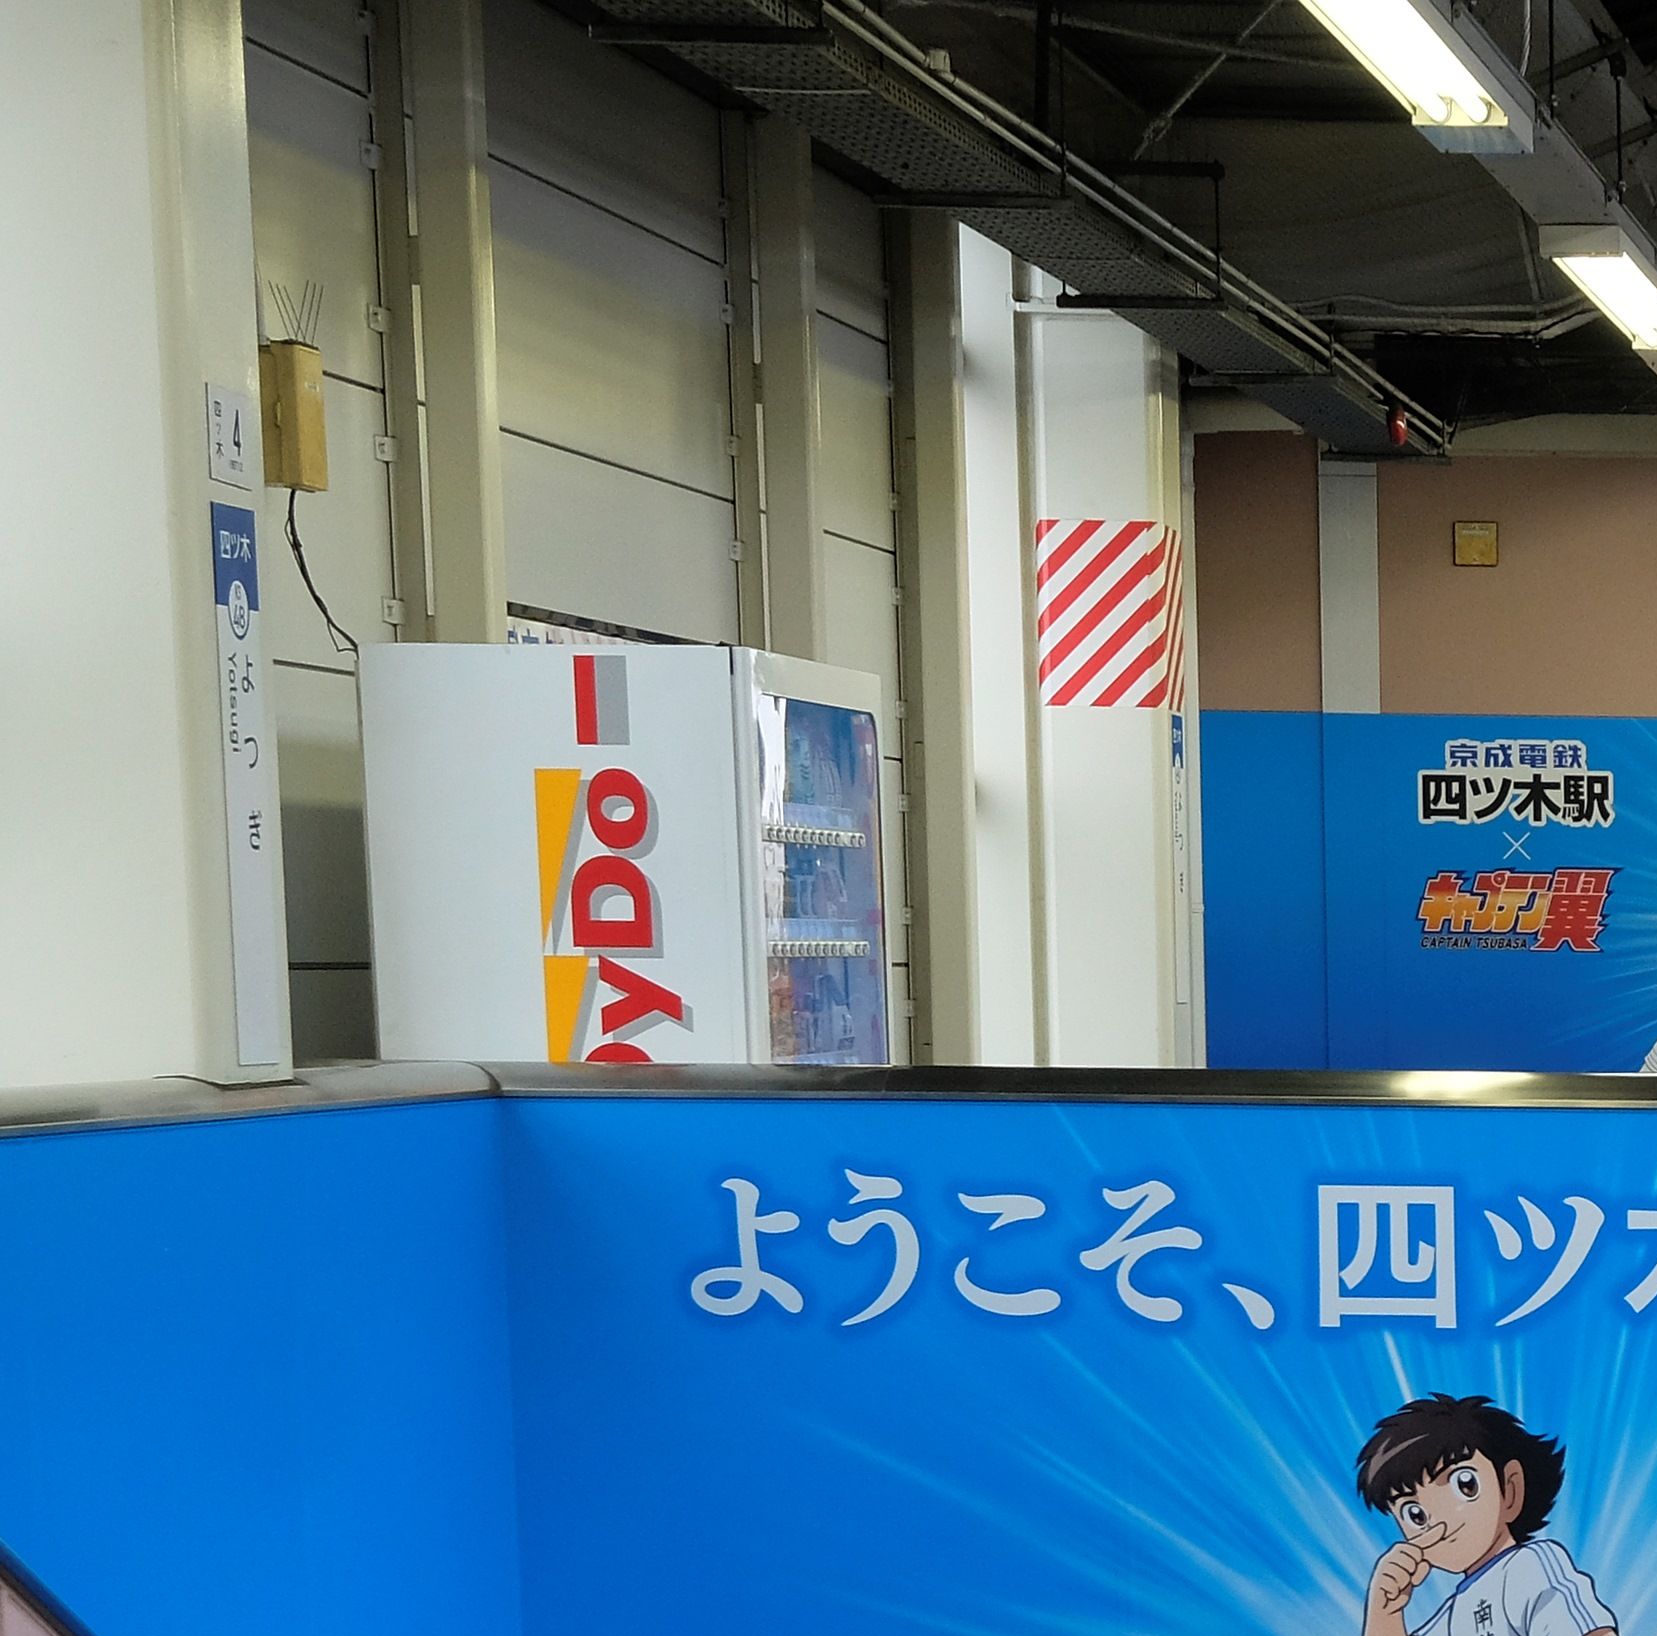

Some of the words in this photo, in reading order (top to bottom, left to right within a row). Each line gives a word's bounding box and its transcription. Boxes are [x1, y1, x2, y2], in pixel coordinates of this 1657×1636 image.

[232, 408, 242, 457] 4
[219, 529, 251, 563] 四ツ木
[227, 652, 242, 753] Yotsugi
[240, 653, 263, 851] よつぎ
[1450, 743, 1582, 769] 京成電鉄
[1422, 773, 1611, 823] 四ツ木駅
[570, 767, 683, 1063] yDo
[1418, 868, 1618, 951] キャプテン翼
[1420, 935, 1472, 949] CAPTAIN
[1476, 936, 1527, 949] TSUBASA
